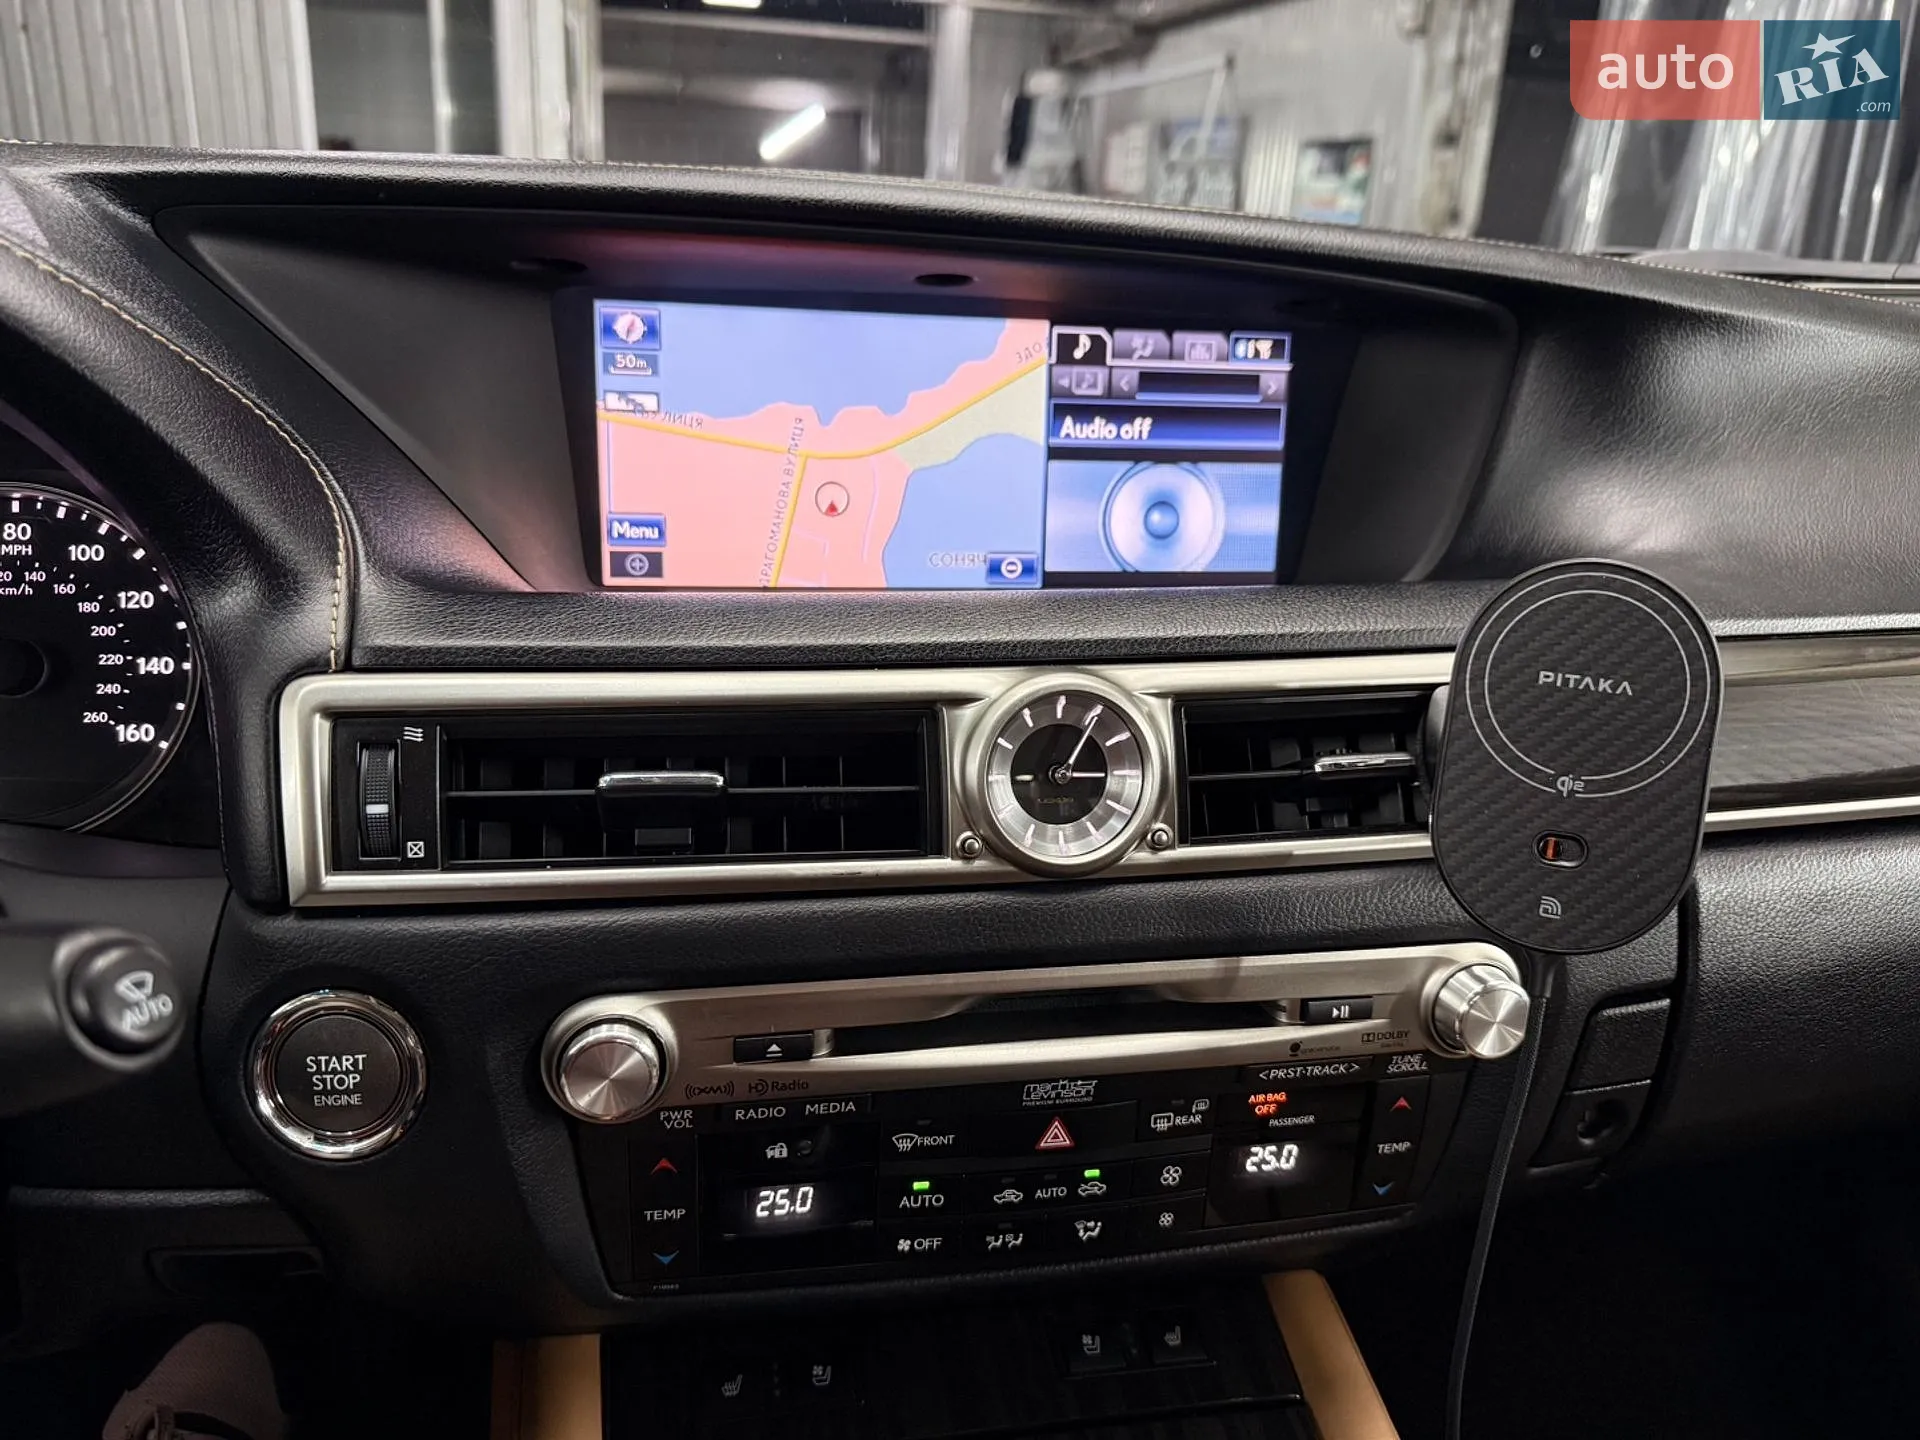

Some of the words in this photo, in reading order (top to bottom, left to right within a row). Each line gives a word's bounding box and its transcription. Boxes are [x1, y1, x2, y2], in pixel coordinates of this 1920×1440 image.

[615, 353, 647, 369] 50m
[1060, 416, 1117, 439] Audio
[1120, 417, 1153, 440] off
[782, 417, 805, 478] ВУЛИЦЯ
[2, 523, 32, 541] 80
[611, 520, 659, 539] Menu
[1, 544, 33, 556] MPH
[67, 544, 105, 561] 100
[24, 571, 46, 582] 140
[53, 583, 76, 594] 160
[117, 591, 155, 609] 120
[77, 602, 100, 613] 180
[90, 625, 117, 637] 200
[98, 653, 124, 665] 220
[136, 656, 175, 675] 140
[95, 683, 122, 695] 240
[1538, 671, 1633, 696] PITAKA
[82, 711, 108, 723] 260
[115, 723, 155, 741] 160
[121, 994, 174, 1030] AUTO
[306, 1054, 367, 1072] START
[1391, 1053, 1424, 1064] TUNE
[1386, 1061, 1429, 1074] SCROLL
[312, 1074, 361, 1091] STOP
[771, 1080, 809, 1092] Radio
[314, 1093, 363, 1107] ENGINE
[659, 1109, 694, 1121] PWR
[735, 1106, 787, 1121] RADIO
[804, 1100, 857, 1116] MEDIA
[1254, 1102, 1278, 1116] OFF
[663, 1119, 694, 1130] VOL
[1174, 1113, 1202, 1126] REAR
[1268, 1114, 1315, 1128] PASSENGER
[916, 1134, 955, 1147] FRONT
[1377, 1141, 1411, 1155] TEMP
[1035, 1186, 1068, 1200] AUTO
[755, 1186, 814, 1219] 25.0
[899, 1194, 945, 1209] AUTO
[644, 1208, 686, 1222] TEMP
[914, 1237, 943, 1251] OFF
